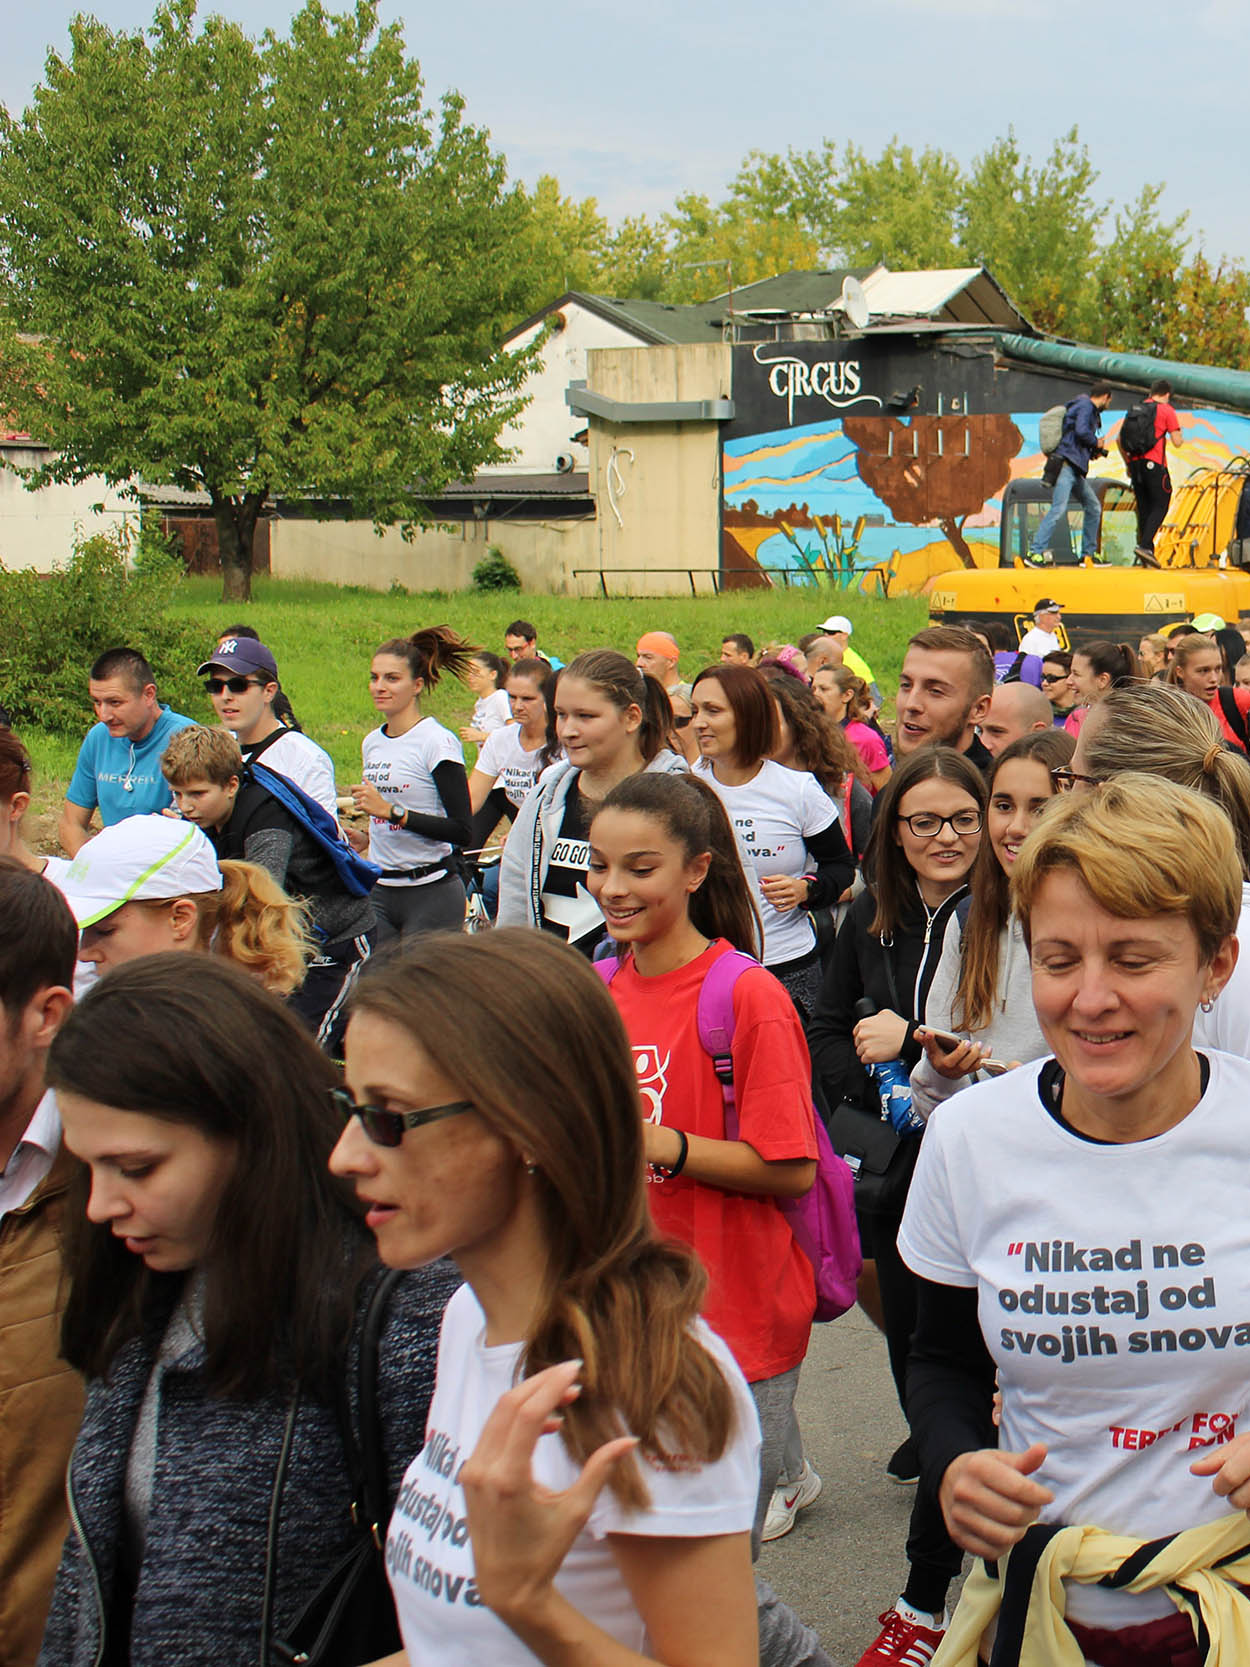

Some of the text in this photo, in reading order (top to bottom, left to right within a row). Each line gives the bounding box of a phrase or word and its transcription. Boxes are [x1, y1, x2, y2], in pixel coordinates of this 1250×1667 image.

[551, 842, 588, 865] GO GO
[1152, 1242, 1206, 1269] ne
[998, 1277, 1216, 1320] odustaj od
[1000, 1325, 1118, 1363] svojih
[1108, 1412, 1239, 1450] TER FO
